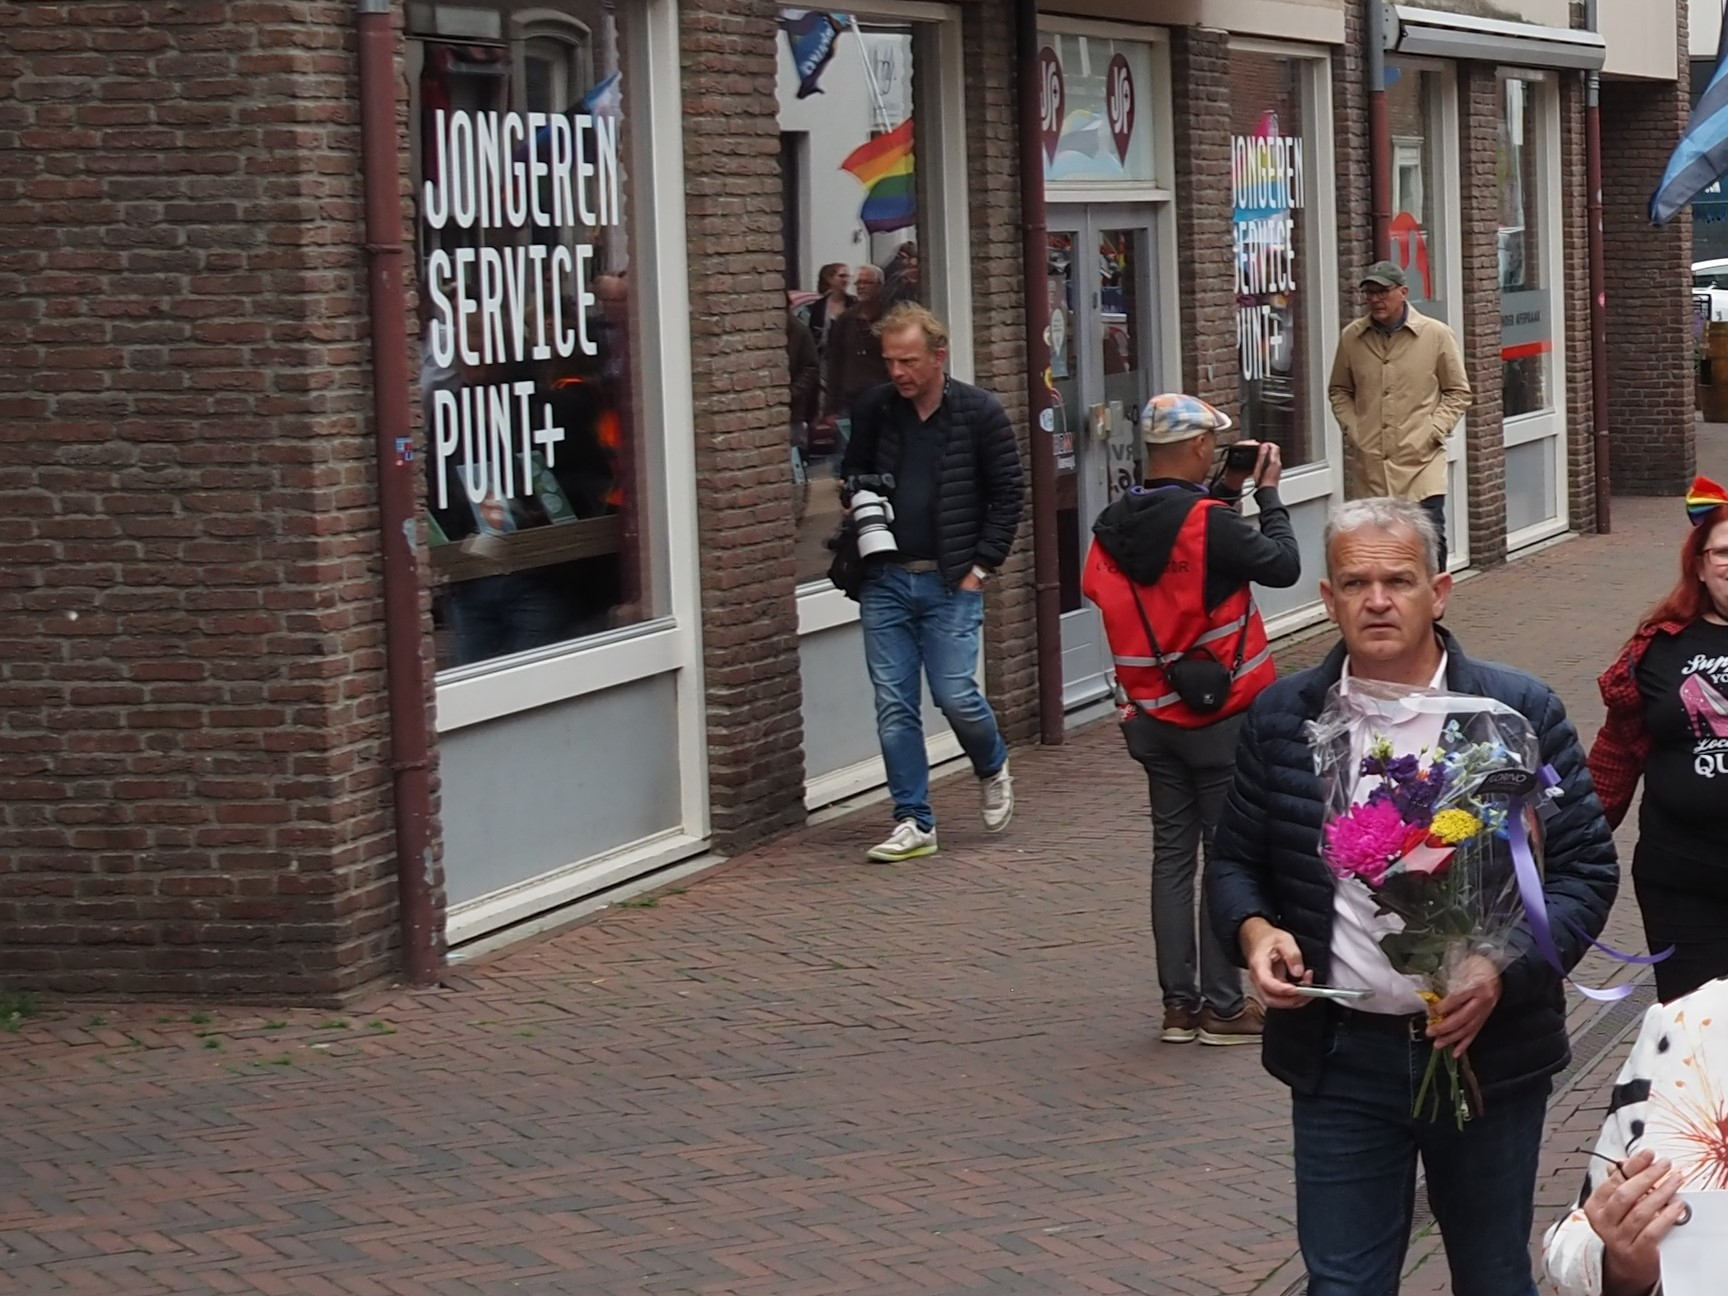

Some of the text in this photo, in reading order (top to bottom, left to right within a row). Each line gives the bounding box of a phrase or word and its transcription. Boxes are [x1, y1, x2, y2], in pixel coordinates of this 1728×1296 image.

[424, 108, 620, 230] JONGEREN
[429, 244, 598, 368] SERVICE
[432, 381, 565, 510] PUNT+
